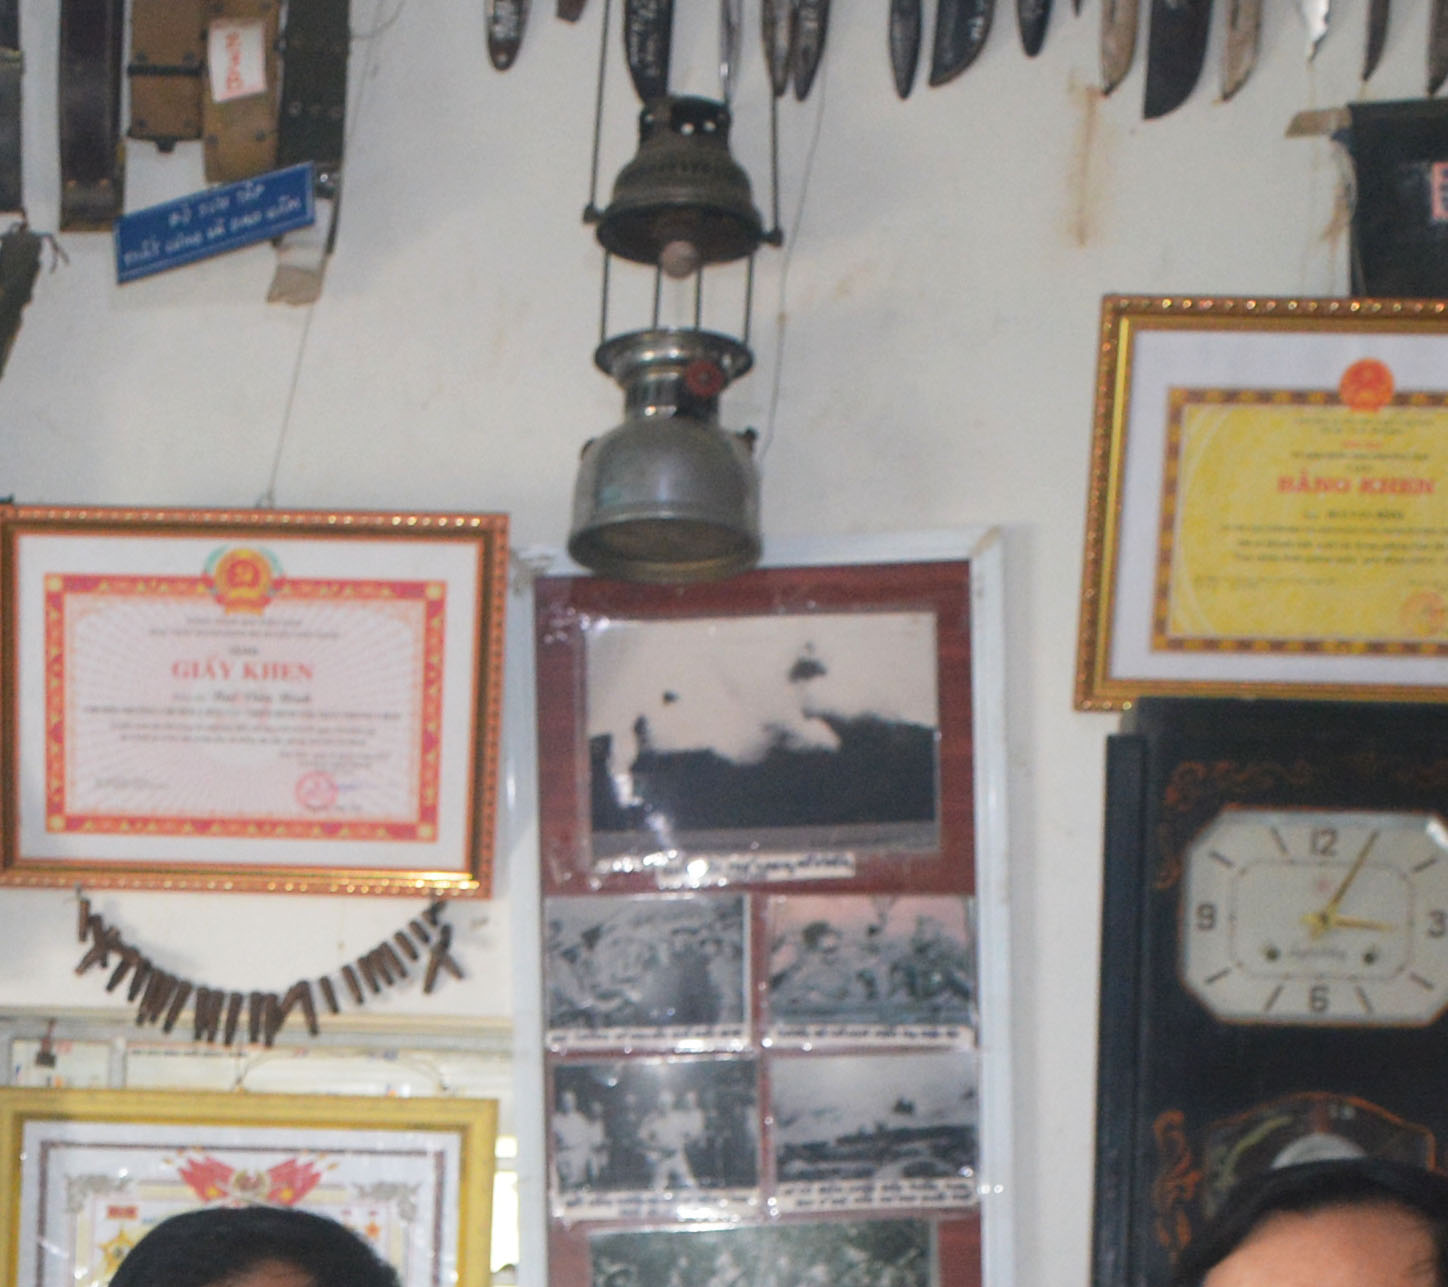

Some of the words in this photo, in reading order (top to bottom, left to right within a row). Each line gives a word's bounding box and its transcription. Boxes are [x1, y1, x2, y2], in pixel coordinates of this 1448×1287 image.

[1358, 475, 1435, 496] KHEN
[171, 654, 232, 681] GIẤY
[242, 660, 315, 682] KHEN
[1309, 828, 1339, 857] 12
[1196, 904, 1216, 931] 9
[1427, 911, 1447, 938] 3
[1309, 986, 1329, 1012] 6
